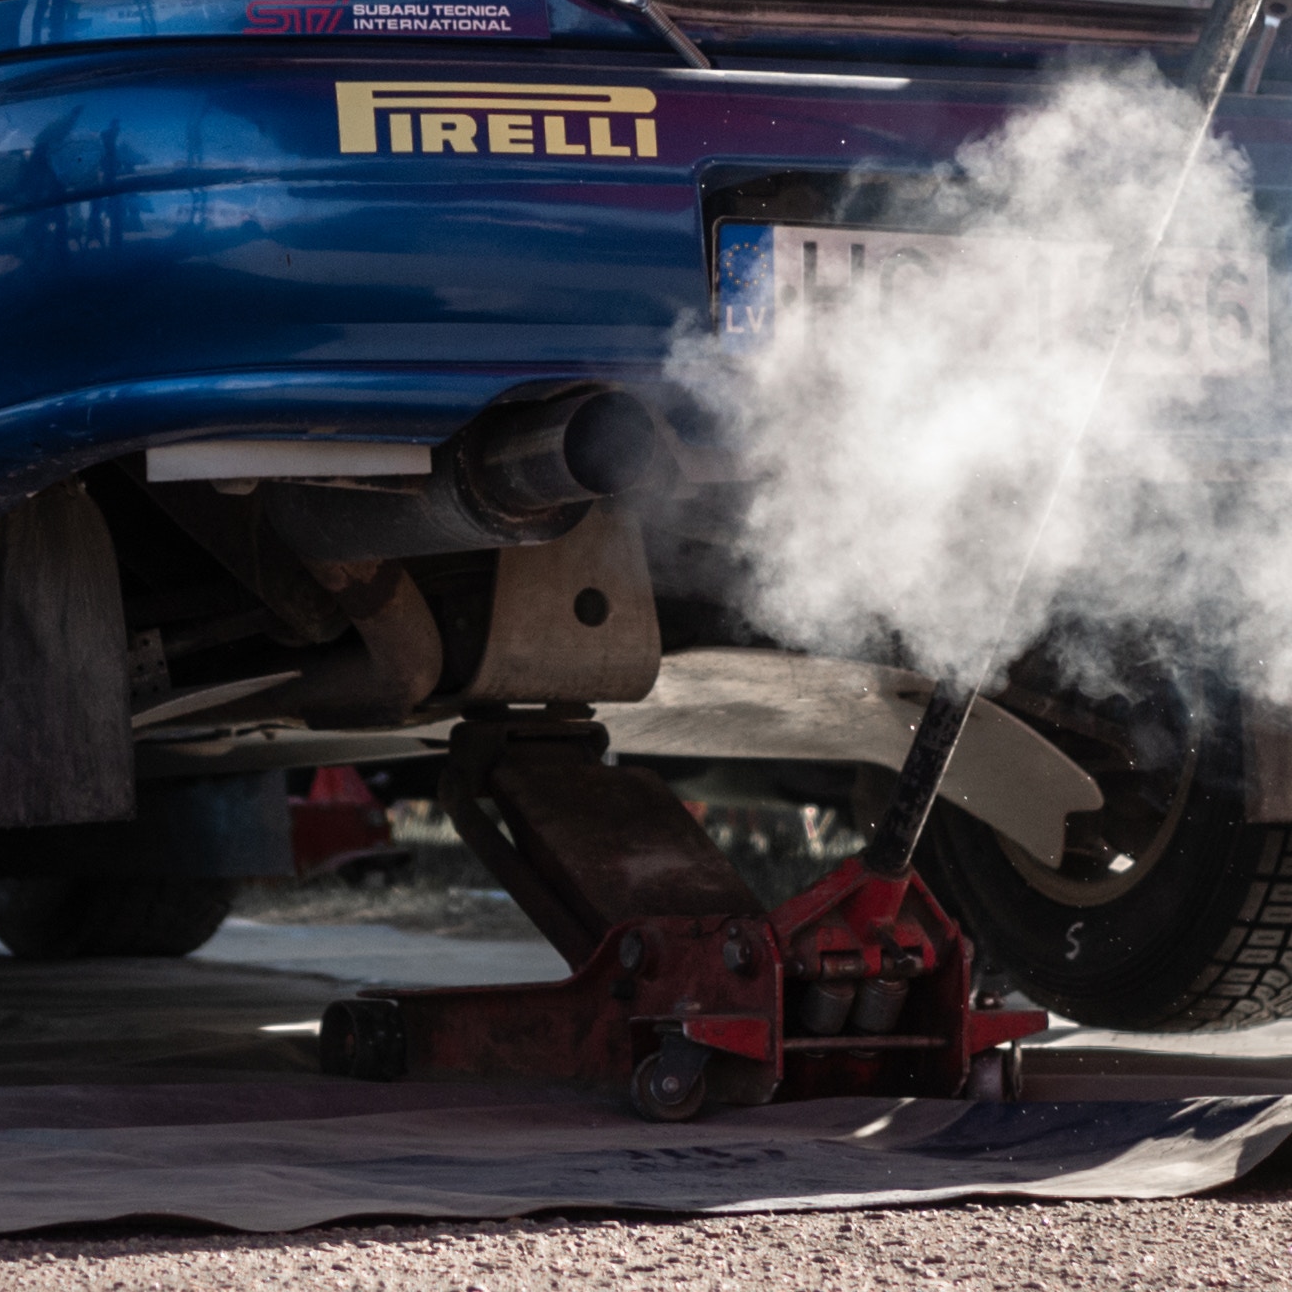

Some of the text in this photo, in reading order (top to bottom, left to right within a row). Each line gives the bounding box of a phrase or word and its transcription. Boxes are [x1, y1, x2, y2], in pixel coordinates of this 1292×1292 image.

[352, 3, 511, 18] SUBARU TECNICA
[353, 18, 512, 32] INTERNATIONAL
[335, 80, 658, 158] PIRELLI
[725, 304, 767, 335] LV
